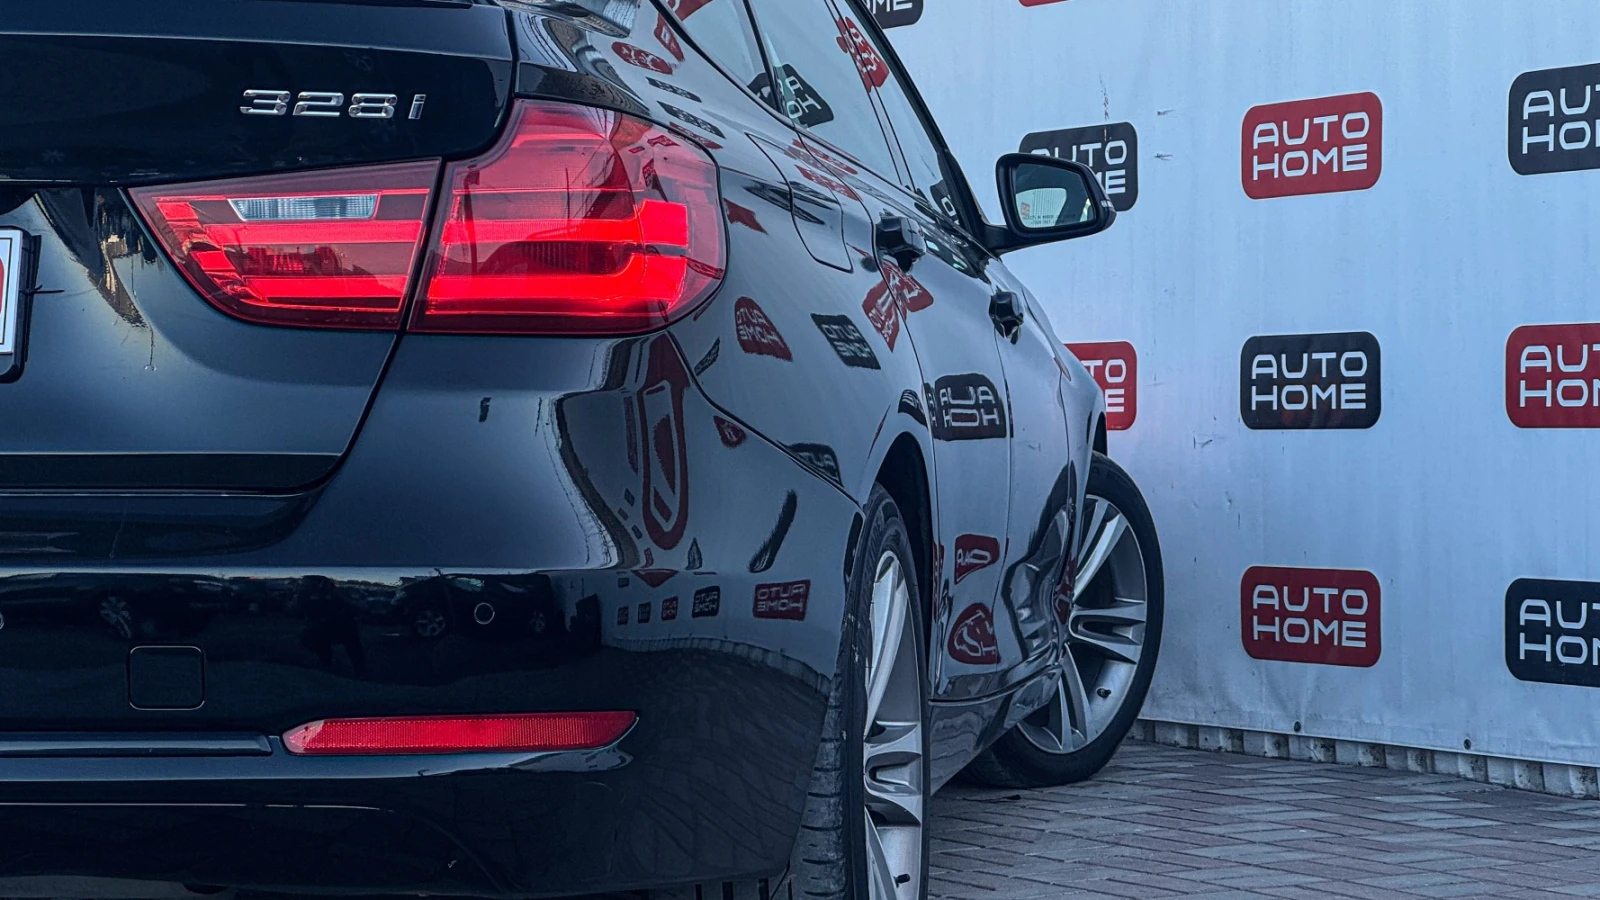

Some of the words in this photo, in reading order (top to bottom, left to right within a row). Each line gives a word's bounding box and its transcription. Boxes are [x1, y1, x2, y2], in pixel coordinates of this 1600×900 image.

[1523, 84, 1600, 120] AU
[1253, 111, 1370, 150] AUTO
[1030, 140, 1128, 168] TO
[1252, 143, 1368, 181] HOME
[1251, 351, 1368, 380] AUTO
[1520, 343, 1600, 374] AU
[1251, 383, 1367, 411] HOME
[1252, 584, 1369, 616] AUTO
[1253, 615, 1368, 648] HOME
